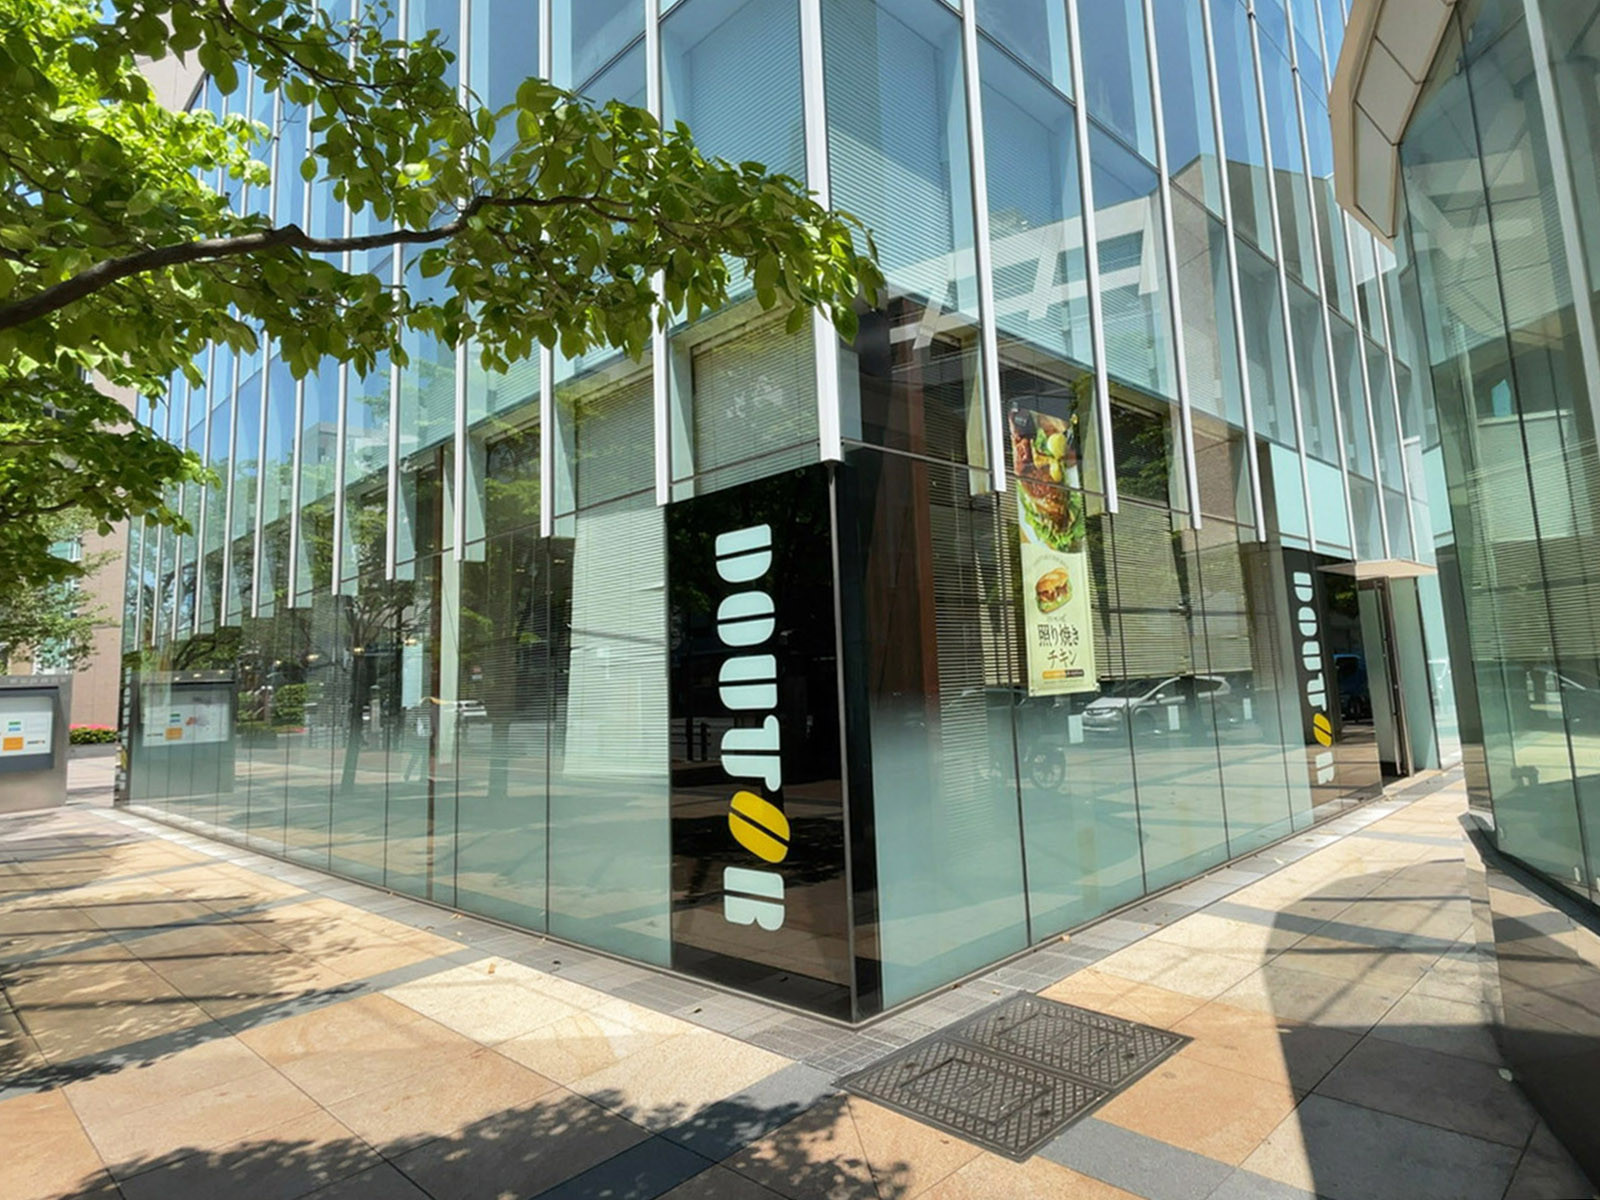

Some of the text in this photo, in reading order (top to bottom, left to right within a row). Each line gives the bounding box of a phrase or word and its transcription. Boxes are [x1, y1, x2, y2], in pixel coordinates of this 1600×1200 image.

[1037, 624, 1079, 647] 照り焼き
[1048, 648, 1077, 669] チキン
[1293, 571, 1335, 785] DOUTOR
[715, 523, 790, 931] DOUTOR
